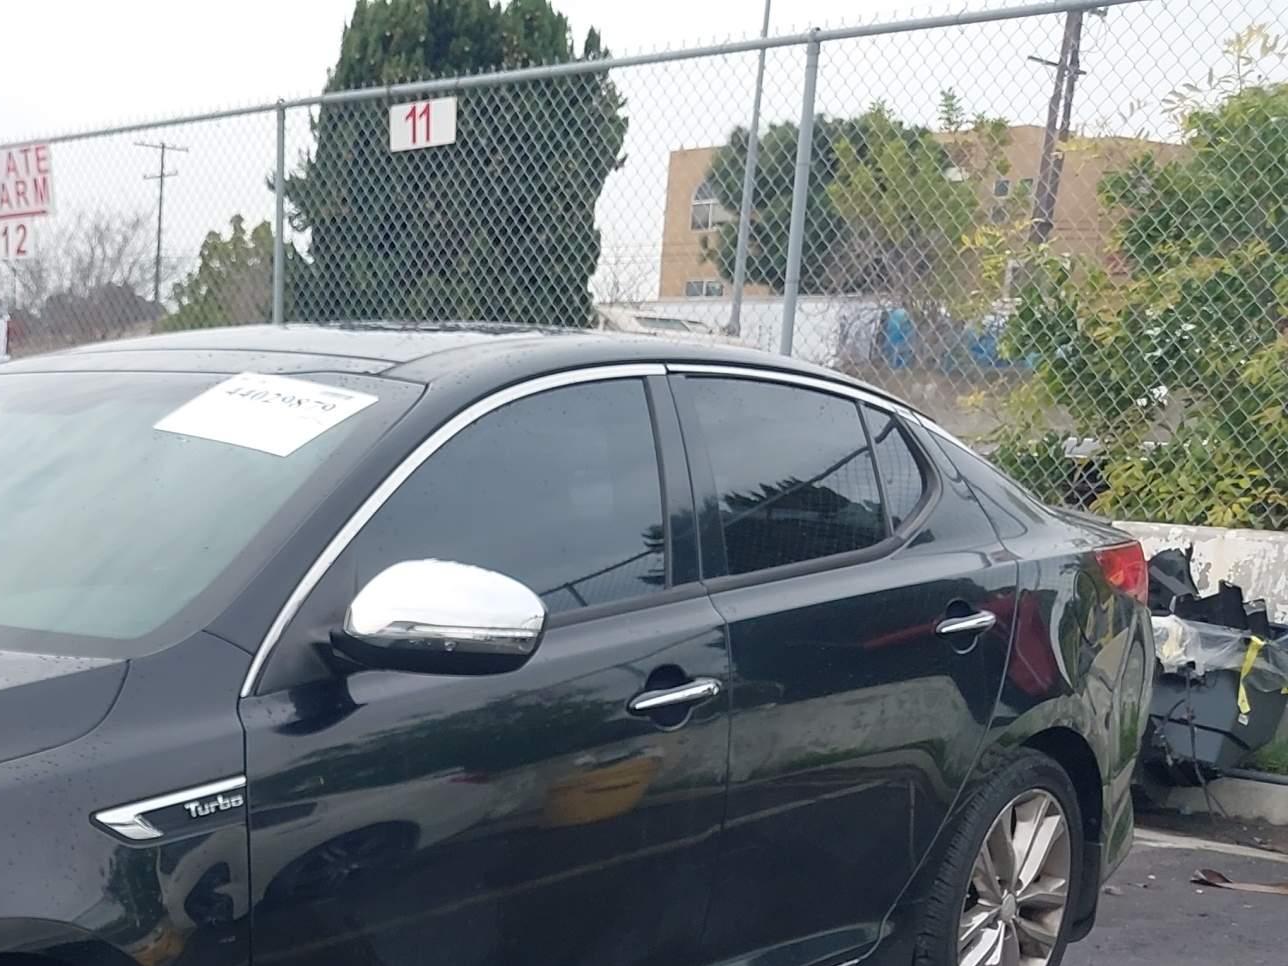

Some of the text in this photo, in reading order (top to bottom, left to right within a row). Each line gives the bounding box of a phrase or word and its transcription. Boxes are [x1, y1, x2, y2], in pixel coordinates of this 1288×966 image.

[404, 103, 430, 144] 11
[2, 224, 27, 255] 12
[183, 794, 244, 818] Turbo
